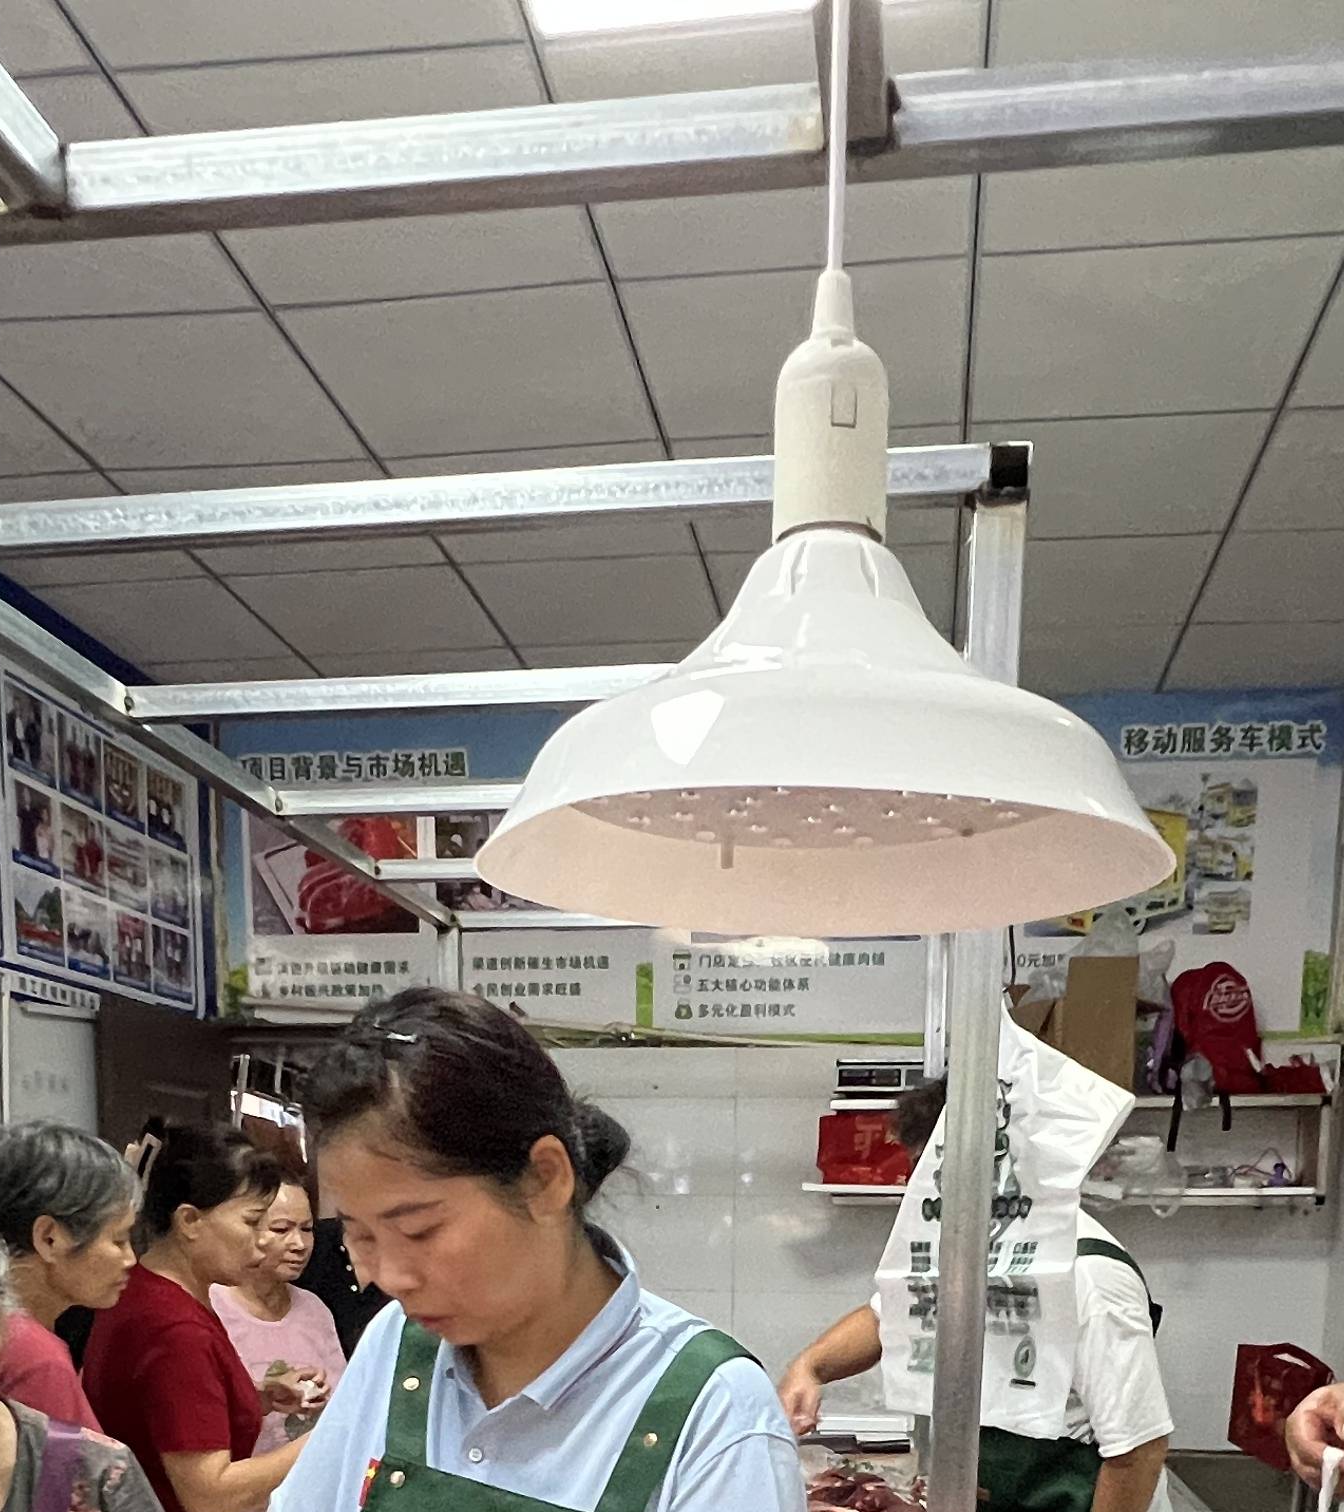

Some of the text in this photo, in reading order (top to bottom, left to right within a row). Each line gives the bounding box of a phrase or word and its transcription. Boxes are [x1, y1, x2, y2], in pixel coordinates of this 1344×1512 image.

[1124, 722, 1327, 755] 移动服务车模式
[241, 750, 467, 781] 项目背景与市场机遇
[697, 977, 810, 992] 五大核心功能体系
